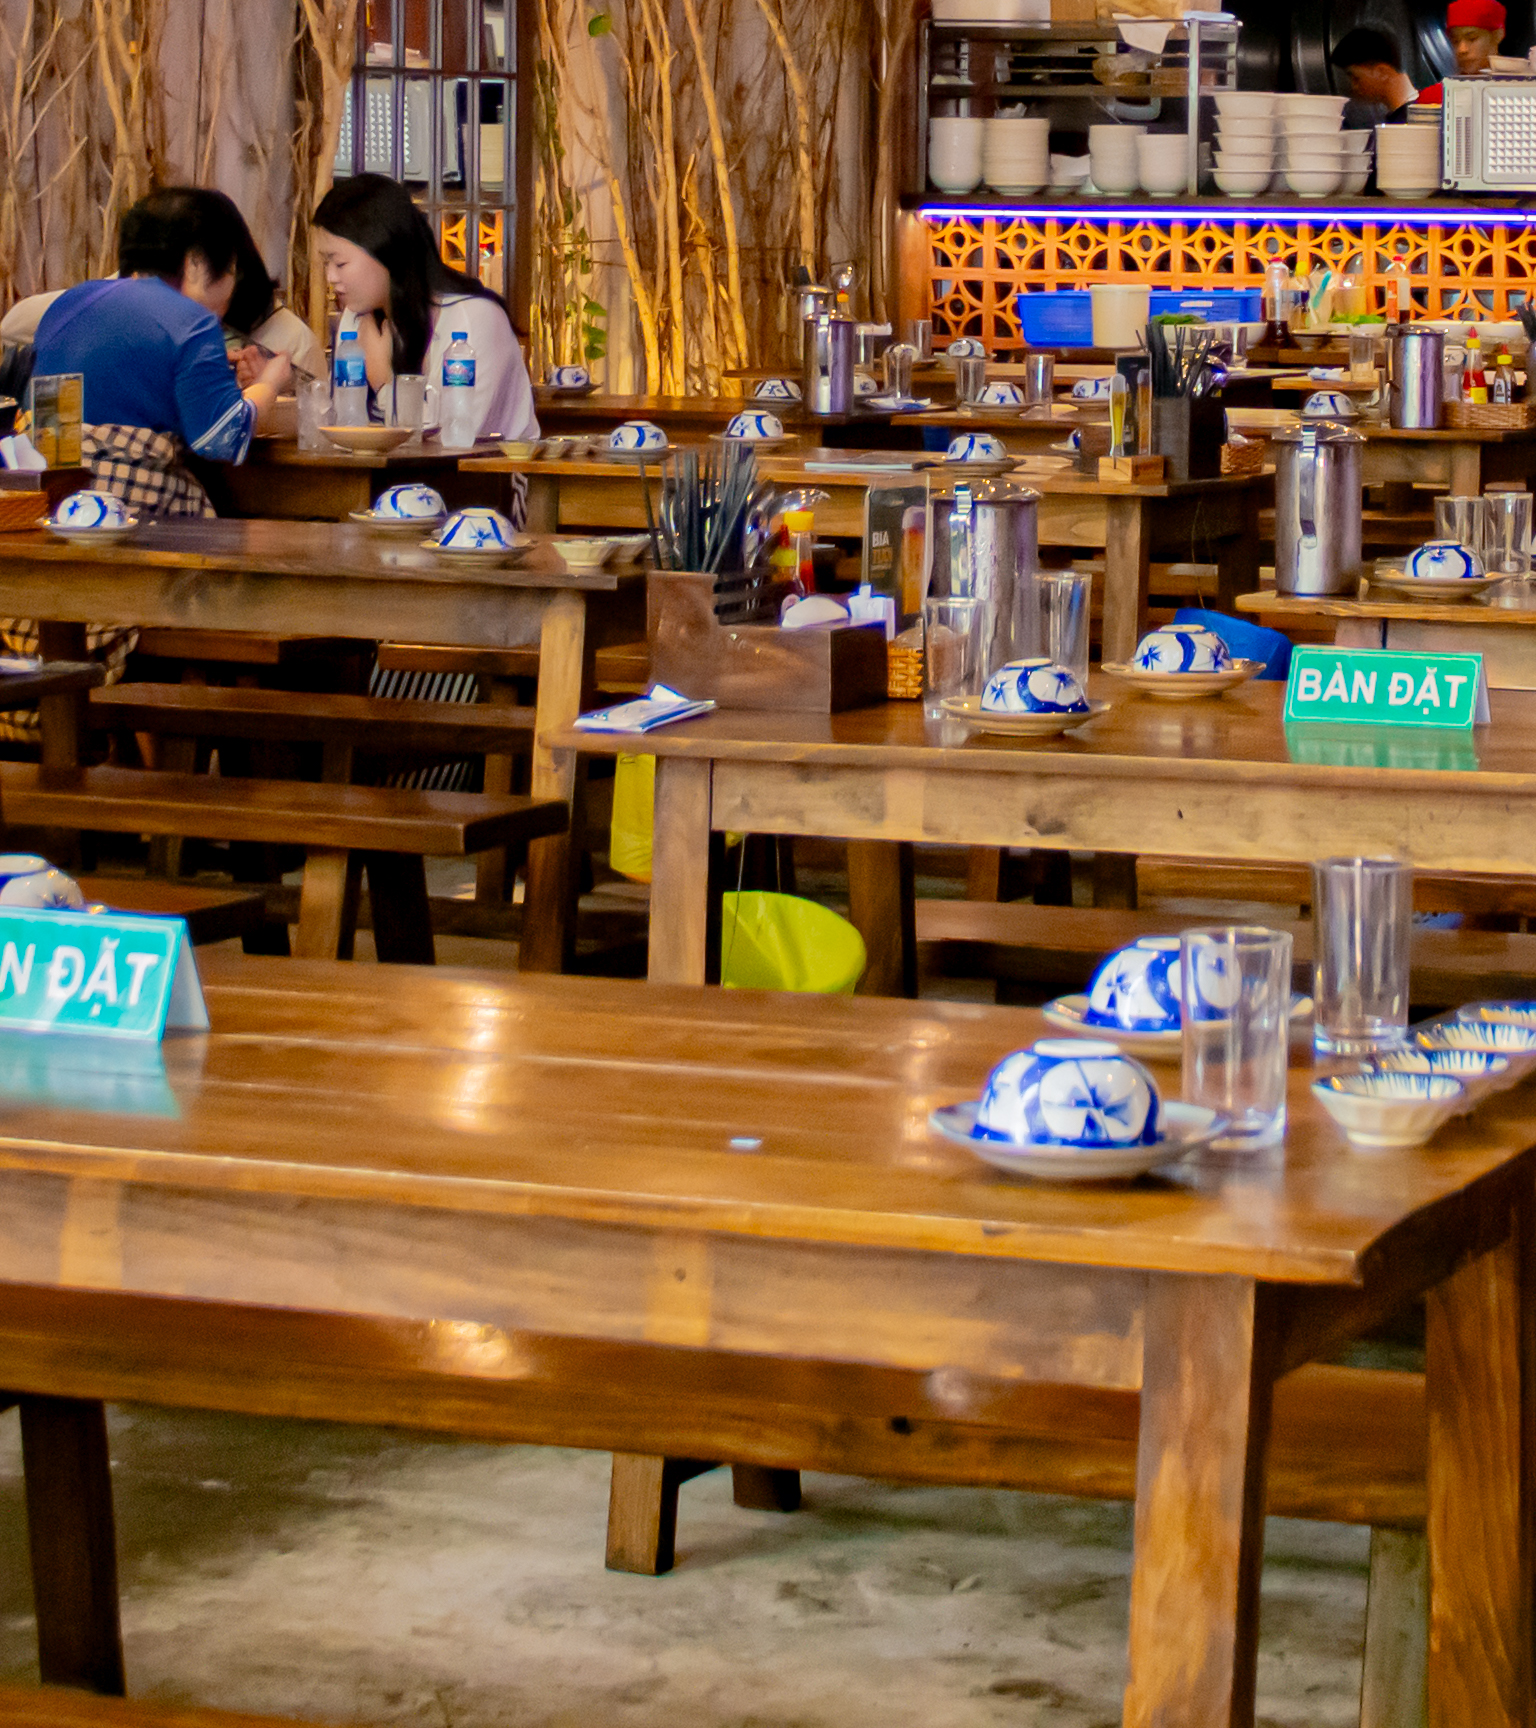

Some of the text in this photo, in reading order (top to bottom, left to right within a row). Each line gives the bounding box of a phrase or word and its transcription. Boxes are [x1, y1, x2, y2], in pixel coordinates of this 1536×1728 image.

[1297, 661, 1468, 715] BÀN ĐẶT
[47, 935, 159, 1017] ĐẶT
